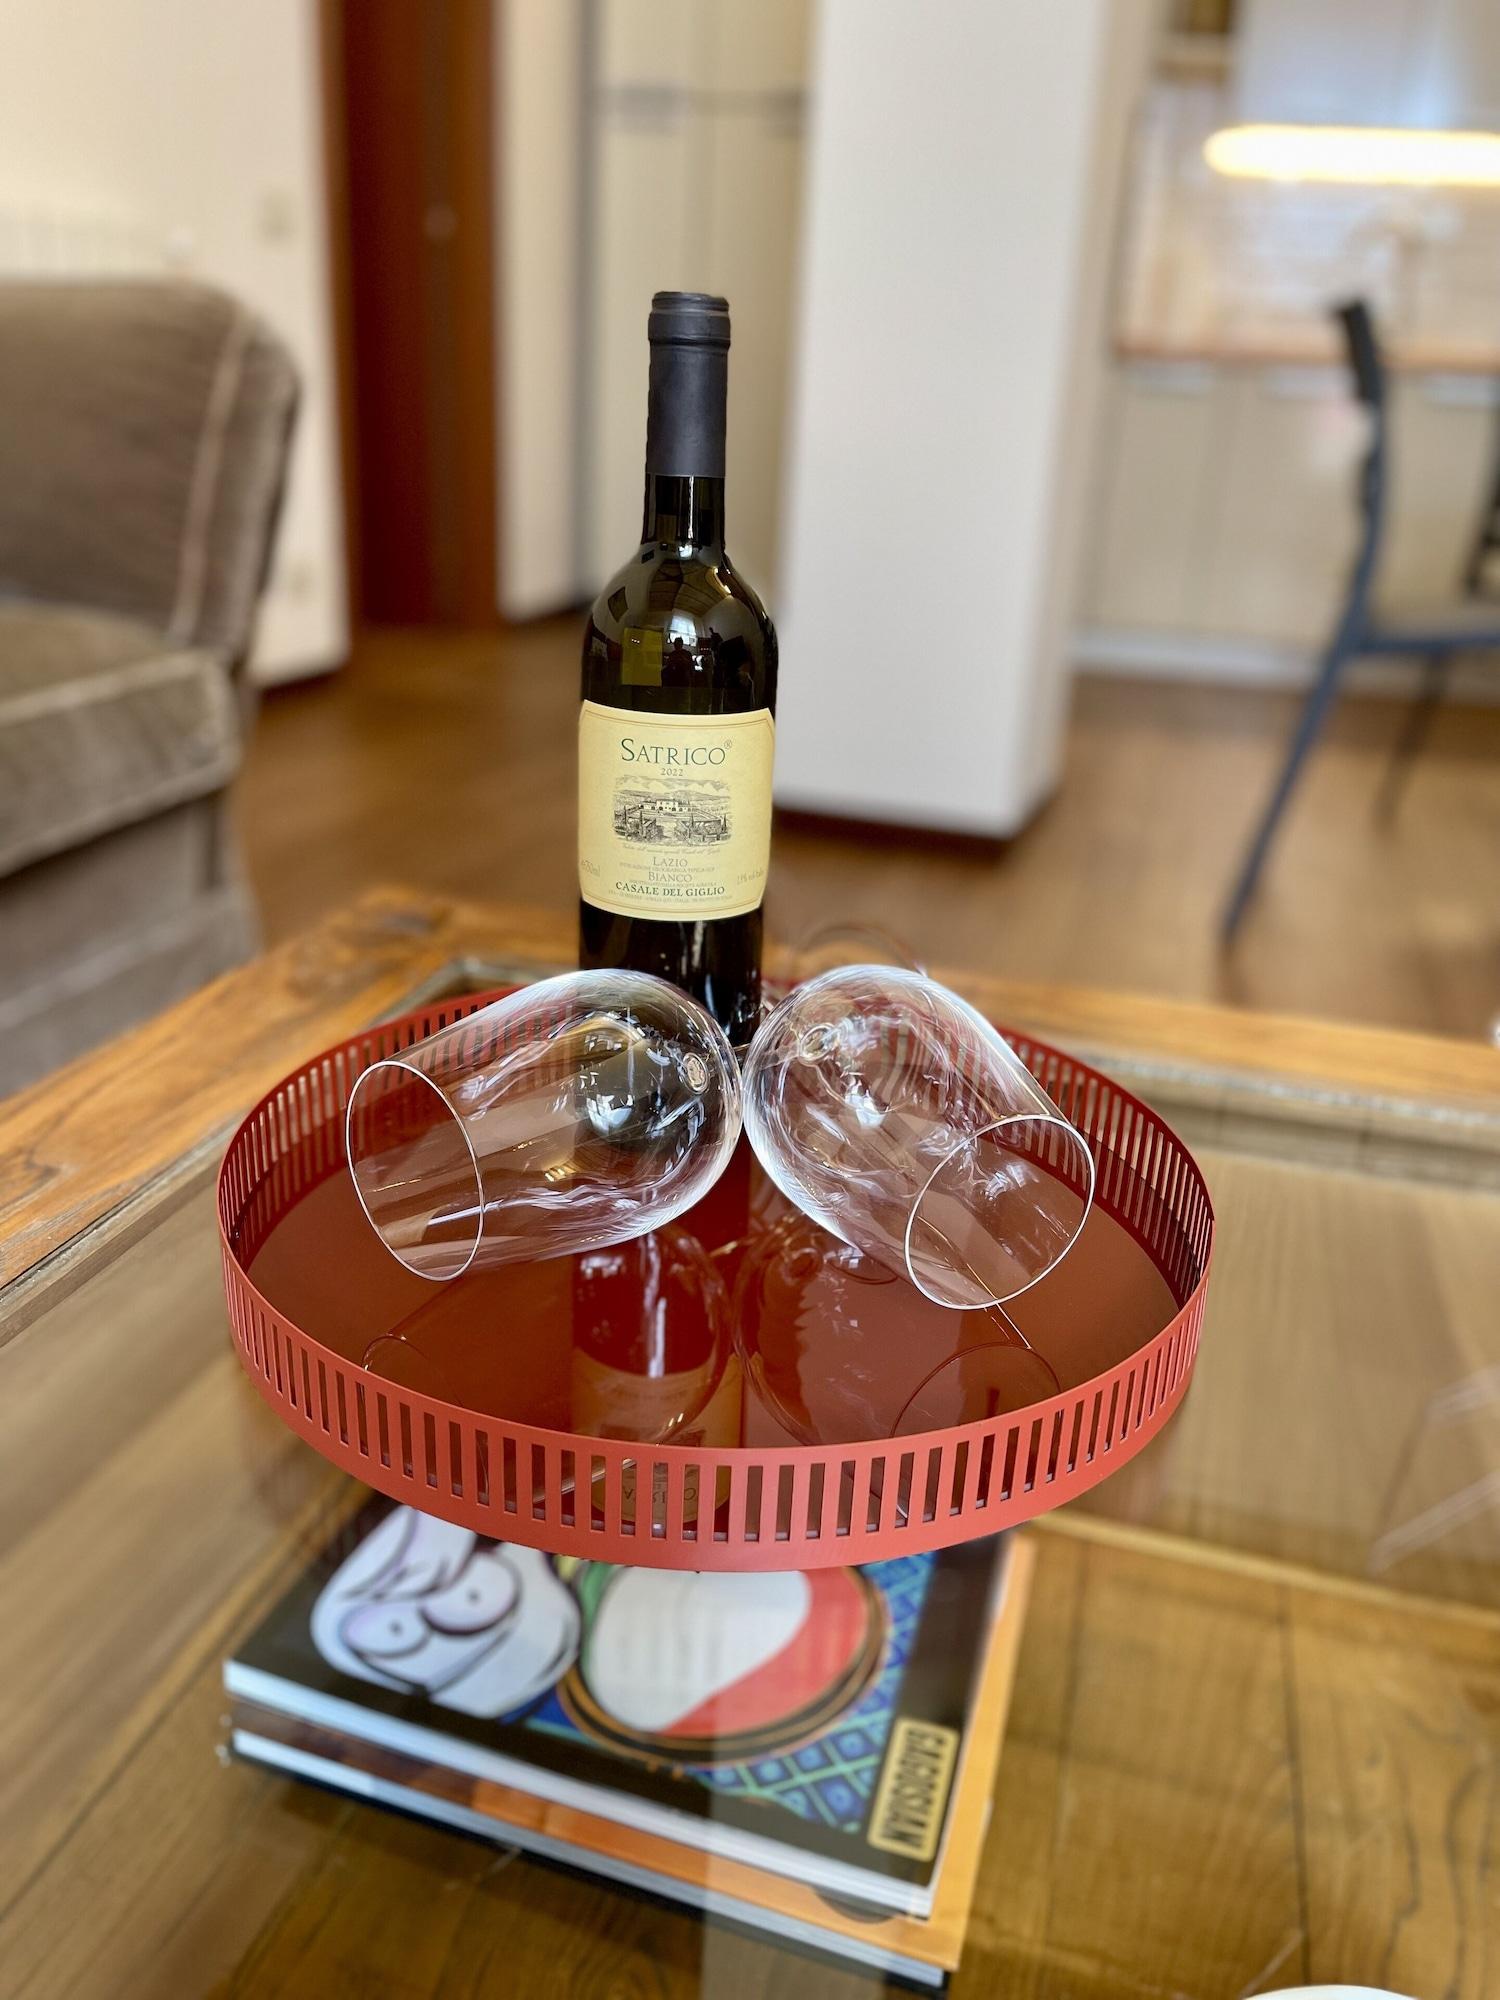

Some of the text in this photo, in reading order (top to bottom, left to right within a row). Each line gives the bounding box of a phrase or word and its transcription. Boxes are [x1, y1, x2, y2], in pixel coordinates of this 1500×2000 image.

[660, 767, 684, 777] 2022
[653, 856, 688, 867] LAZIO
[648, 871, 693, 883] BIANCO
[615, 881, 660, 896] CASALE
[662, 888, 684, 897] DEL
[685, 886, 725, 897] GIGLIO
